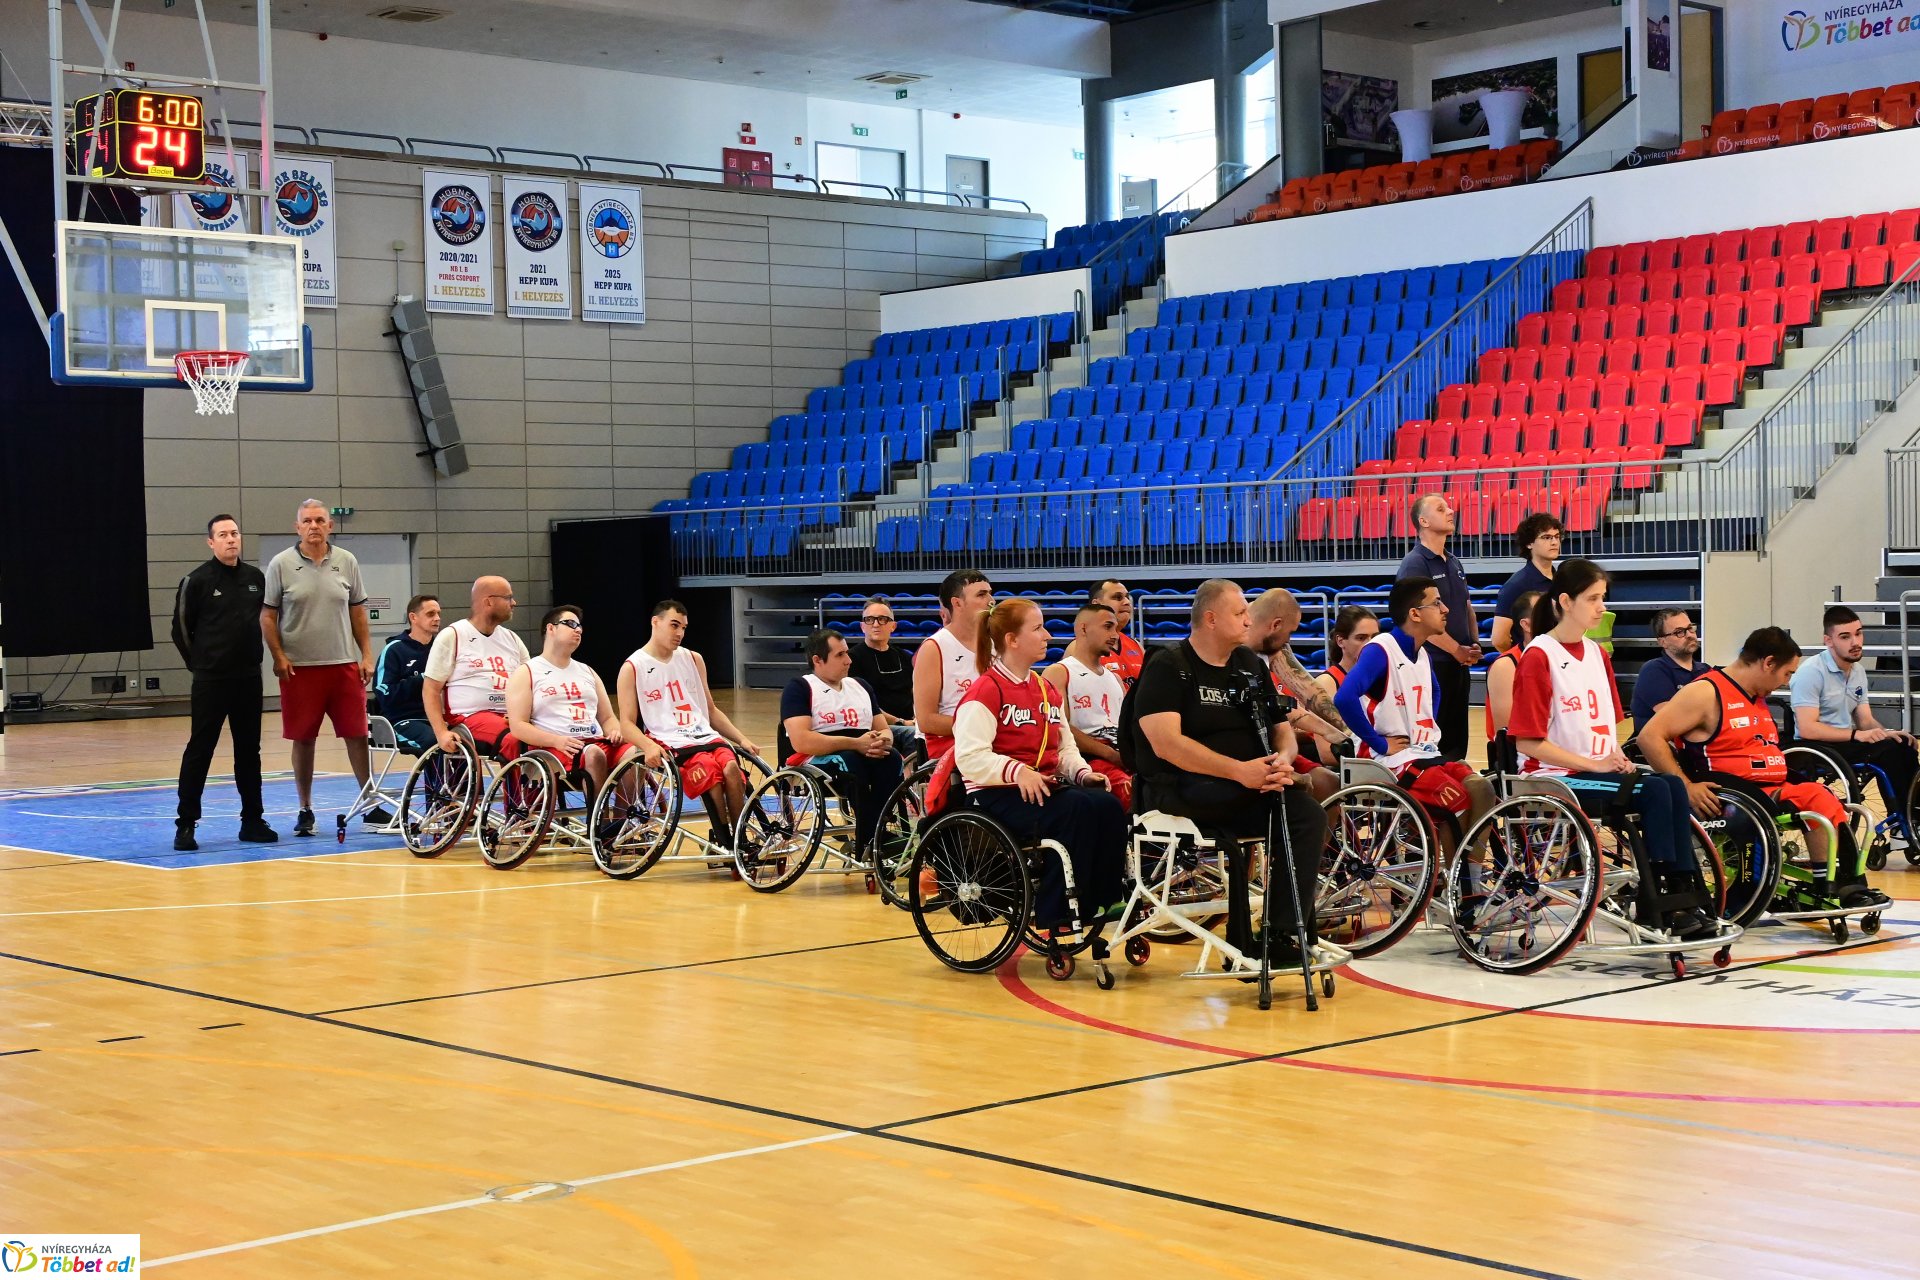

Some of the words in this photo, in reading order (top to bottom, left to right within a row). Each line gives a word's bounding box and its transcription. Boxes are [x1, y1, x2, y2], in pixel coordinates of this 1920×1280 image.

[1825, 17, 1893, 45] Többet
[139, 97, 198, 126] 6:00
[135, 126, 186, 167] 24
[150, 166, 172, 175] Bodet
[291, 169, 329, 207] SHARKS
[439, 252, 478, 263] 2020/2021
[530, 264, 547, 274] 2021
[604, 269, 621, 279] 2025
[438, 273, 456, 281] PIROS
[456, 274, 480, 282] CSOPORT
[519, 276, 538, 285] HEPP
[540, 277, 559, 287] KUPA
[442, 284, 486, 297] HELYEZÉS
[594, 281, 612, 290] HEPP
[614, 282, 632, 291] KUPA
[522, 290, 564, 303] HELYEZÉS
[598, 294, 639, 307] HELYEZÉS
[487, 656, 506, 672] 18
[560, 682, 582, 700] 14
[665, 680, 684, 702] 11
[1412, 685, 1423, 714] 7
[1588, 689, 1599, 720] 9
[839, 708, 858, 727] 10
[1000, 703, 1037, 728] New
